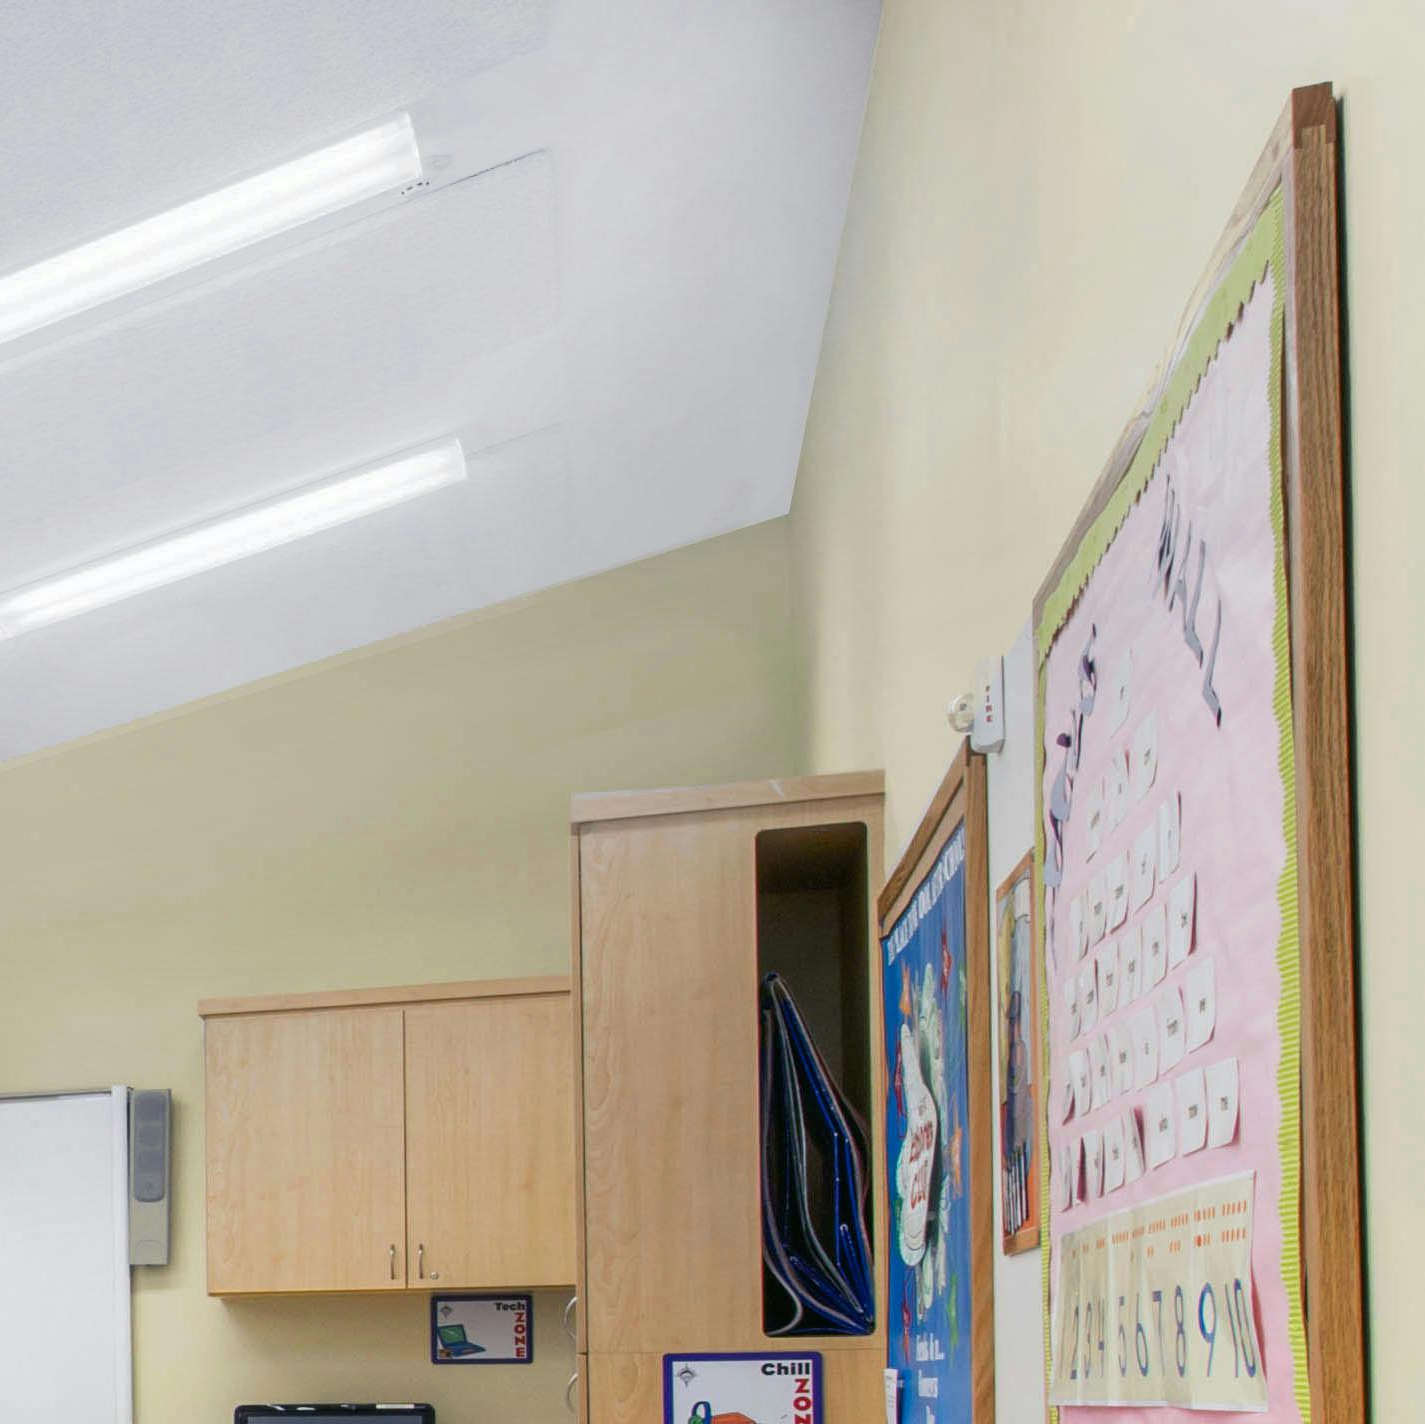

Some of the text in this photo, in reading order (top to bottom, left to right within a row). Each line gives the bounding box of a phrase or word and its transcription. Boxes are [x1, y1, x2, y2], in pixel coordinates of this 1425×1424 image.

[494, 1302, 526, 1311] Tech
[514, 1312, 526, 1358] ZONE
[1118, 1296, 1127, 1377] 5
[1135, 1292, 1149, 1377] 6
[1152, 1290, 1165, 1377] 7
[1174, 1284, 1186, 1378] 8
[1198, 1282, 1217, 1378] 9
[1224, 1277, 1256, 1378] 10
[761, 1362, 811, 1376] Chill
